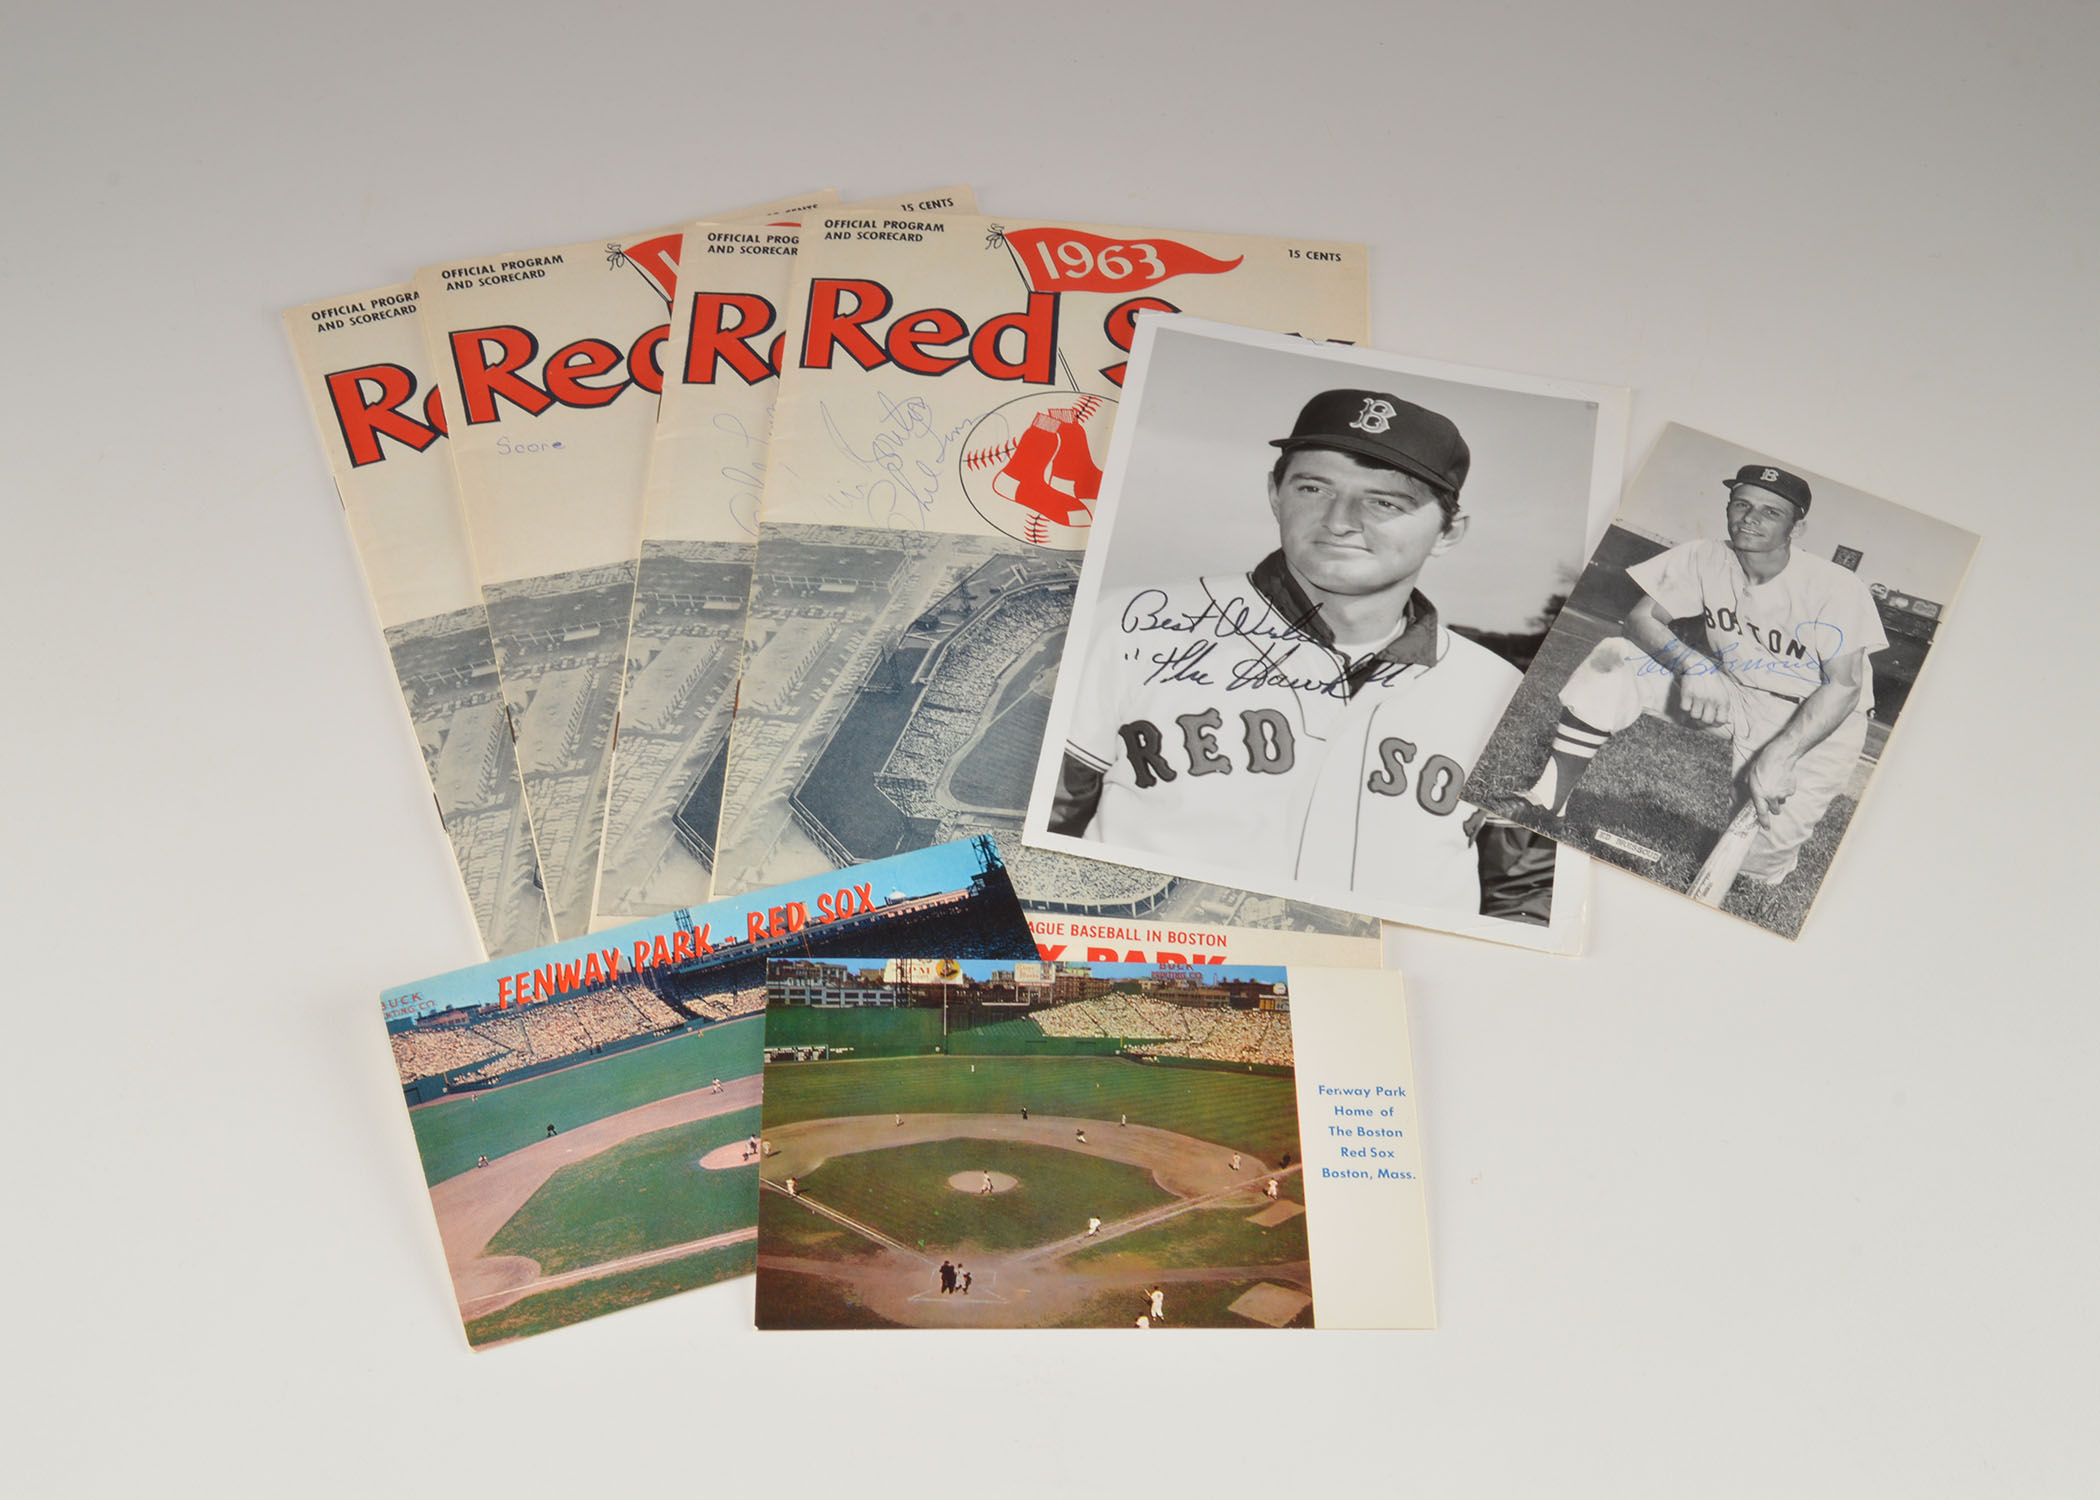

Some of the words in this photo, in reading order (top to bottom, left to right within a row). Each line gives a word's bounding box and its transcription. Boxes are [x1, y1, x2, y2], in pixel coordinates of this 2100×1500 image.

[900, 204, 915, 213] 15
[918, 198, 954, 211] CENTS
[824, 219, 877, 229] OFFICIAL
[883, 220, 945, 232] PROGRAM
[707, 232, 760, 244] OFFICIAL
[824, 231, 852, 240] AND
[856, 231, 924, 242] SCORECARD
[707, 245, 735, 254] AND
[1287, 248, 1302, 259] 15
[1305, 250, 1342, 262] CENTS
[441, 264, 496, 280] OFFICIAL
[501, 254, 564, 271] PROGRAM
[1035, 240, 1167, 281] 1963
[446, 279, 474, 291] AND
[478, 269, 546, 287] SCORECARD
[311, 302, 367, 321] OFFICIAL
[317, 320, 345, 333] AND
[349, 304, 417, 326] SCORECARD
[798, 277, 1062, 386] Red
[1348, 397, 1397, 434] B
[496, 436, 567, 456] Score
[1121, 589, 1218, 634] Best
[1704, 605, 1807, 661] BOSTON
[1117, 707, 1296, 789] RED
[1367, 736, 1487, 849] SO
[1070, 923, 1142, 942] BASEBALL
[1146, 929, 1162, 942] IN
[1168, 931, 1228, 947] BOSTON
[496, 947, 622, 1010] FENWAY
[633, 923, 715, 973] PARK
[747, 901, 806, 943] RED
[817, 882, 878, 924] SOX
[1318, 1084, 1371, 1098] Fenway
[1375, 1086, 1407, 1097] Park
[1334, 1105, 1374, 1116] Home
[1380, 1106, 1394, 1117] of
[1328, 1125, 1353, 1137] The
[1357, 1126, 1403, 1138] Boston
[1340, 1146, 1367, 1158] Red
[1370, 1147, 1395, 1158] Sox
[1322, 1167, 1374, 1180] Boston,
[1377, 1168, 1416, 1180] Mass.
